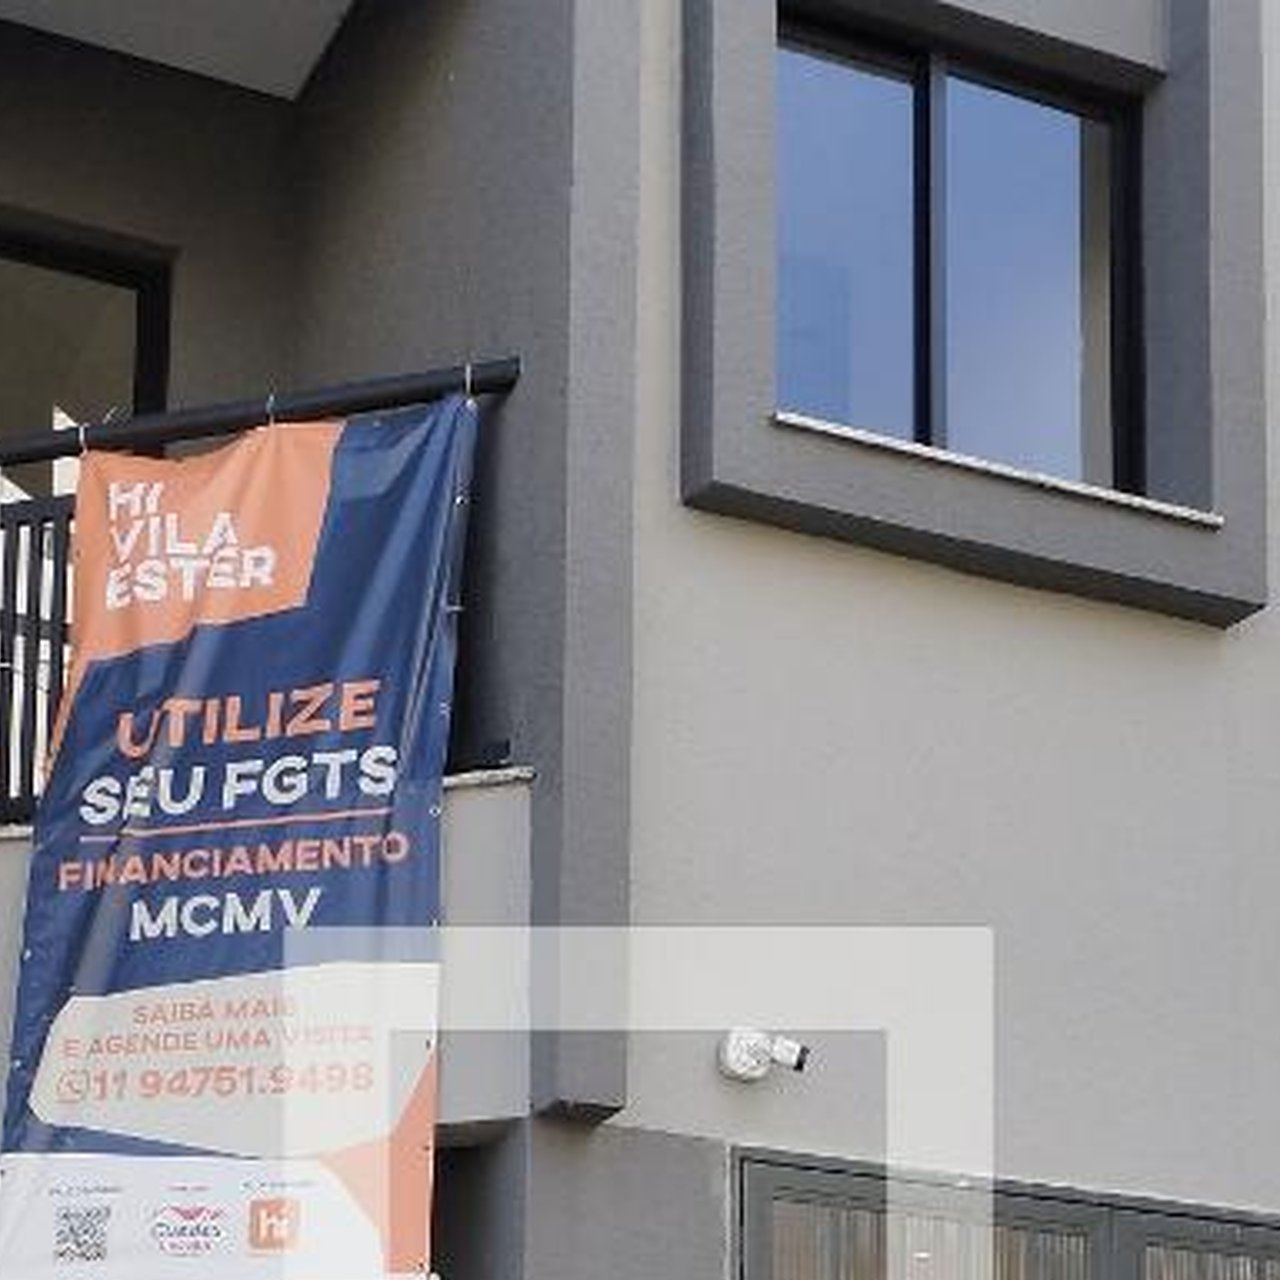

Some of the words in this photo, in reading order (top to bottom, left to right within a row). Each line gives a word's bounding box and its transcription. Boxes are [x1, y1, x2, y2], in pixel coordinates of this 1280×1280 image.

[110, 513, 239, 560] VILA
[106, 546, 276, 610] ESTER
[117, 680, 380, 760] UTILIZE
[80, 766, 205, 825] SEU
[222, 746, 398, 810] FGTS
[58, 831, 410, 892] FINANCIAMENTO
[130, 888, 322, 941] MCMV
[132, 1002, 216, 1027] SAIBA
[63, 1039, 81, 1057] E
[85, 1032, 198, 1056] AGENDE
[204, 1028, 271, 1049] UMA
[95, 1069, 128, 1100] 11
